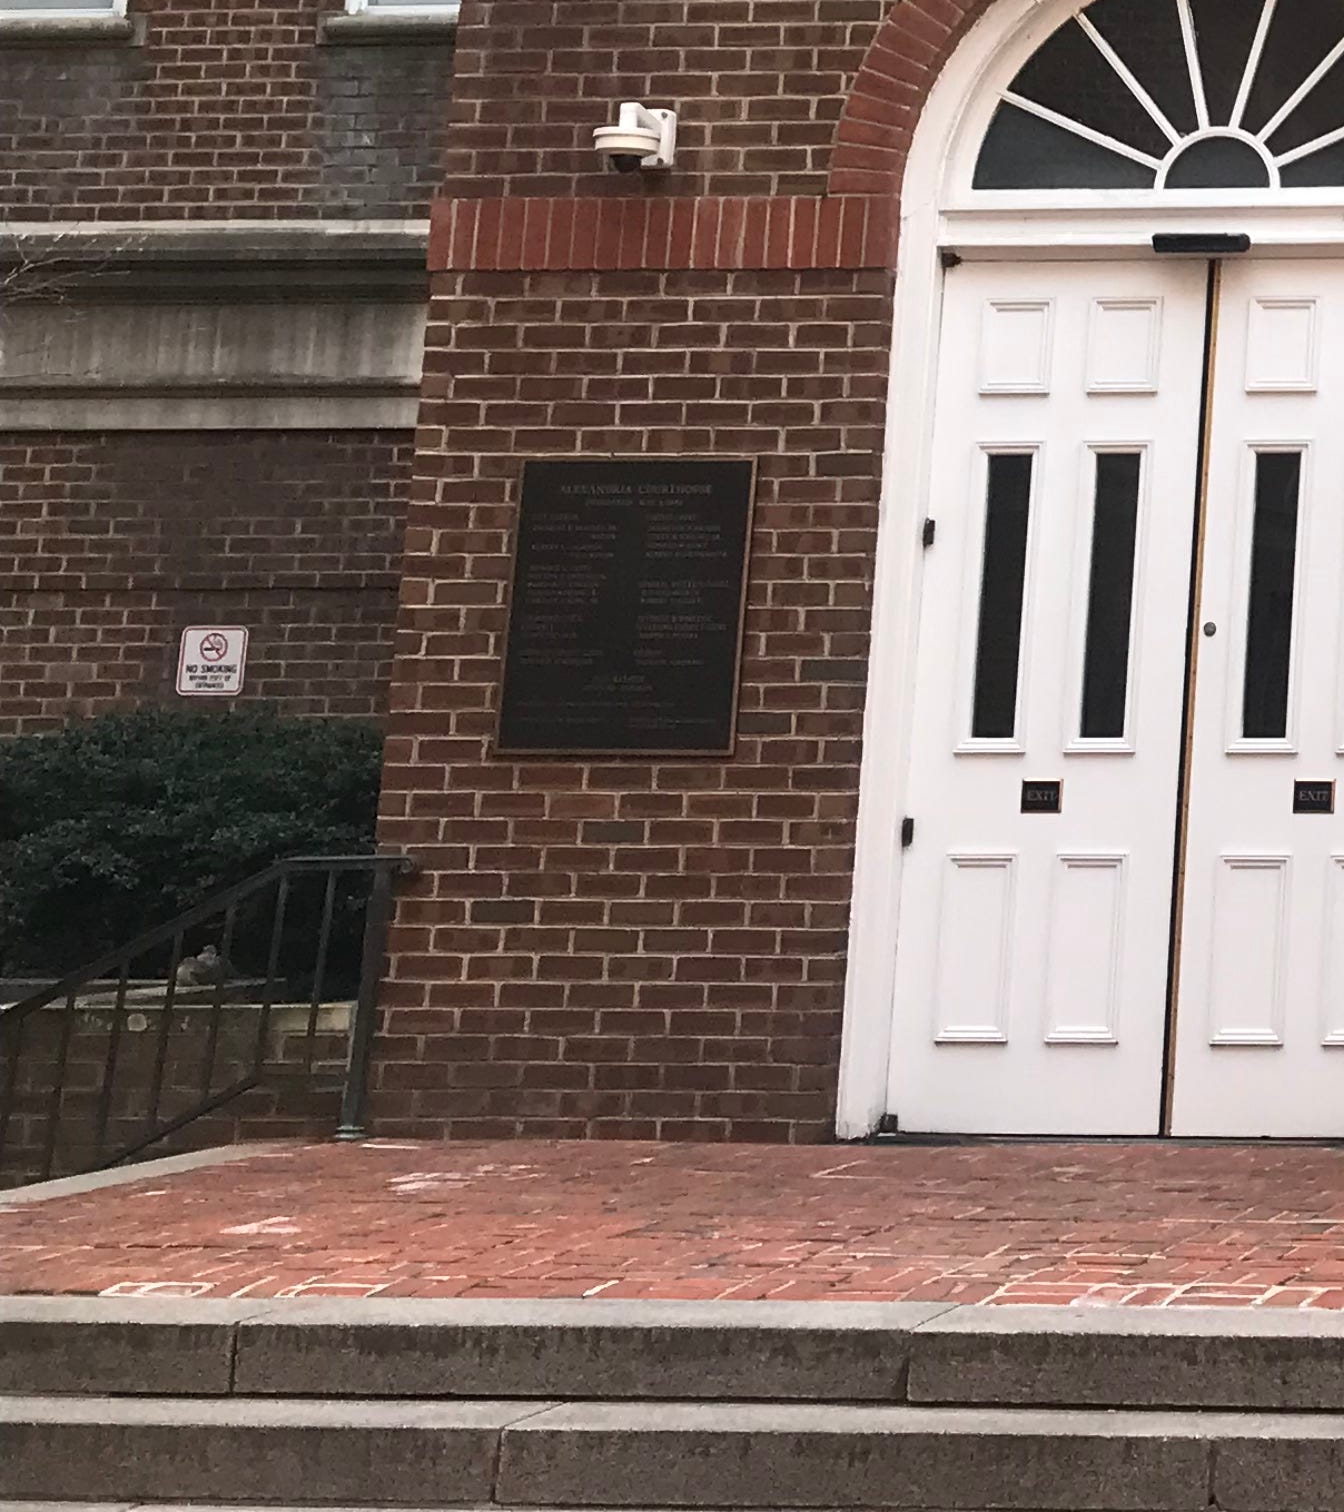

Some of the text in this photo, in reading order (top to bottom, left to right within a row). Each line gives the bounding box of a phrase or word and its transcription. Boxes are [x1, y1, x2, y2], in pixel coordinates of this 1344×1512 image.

[186, 664, 238, 674] NO SMOKING
[1299, 790, 1329, 801] EXIT
